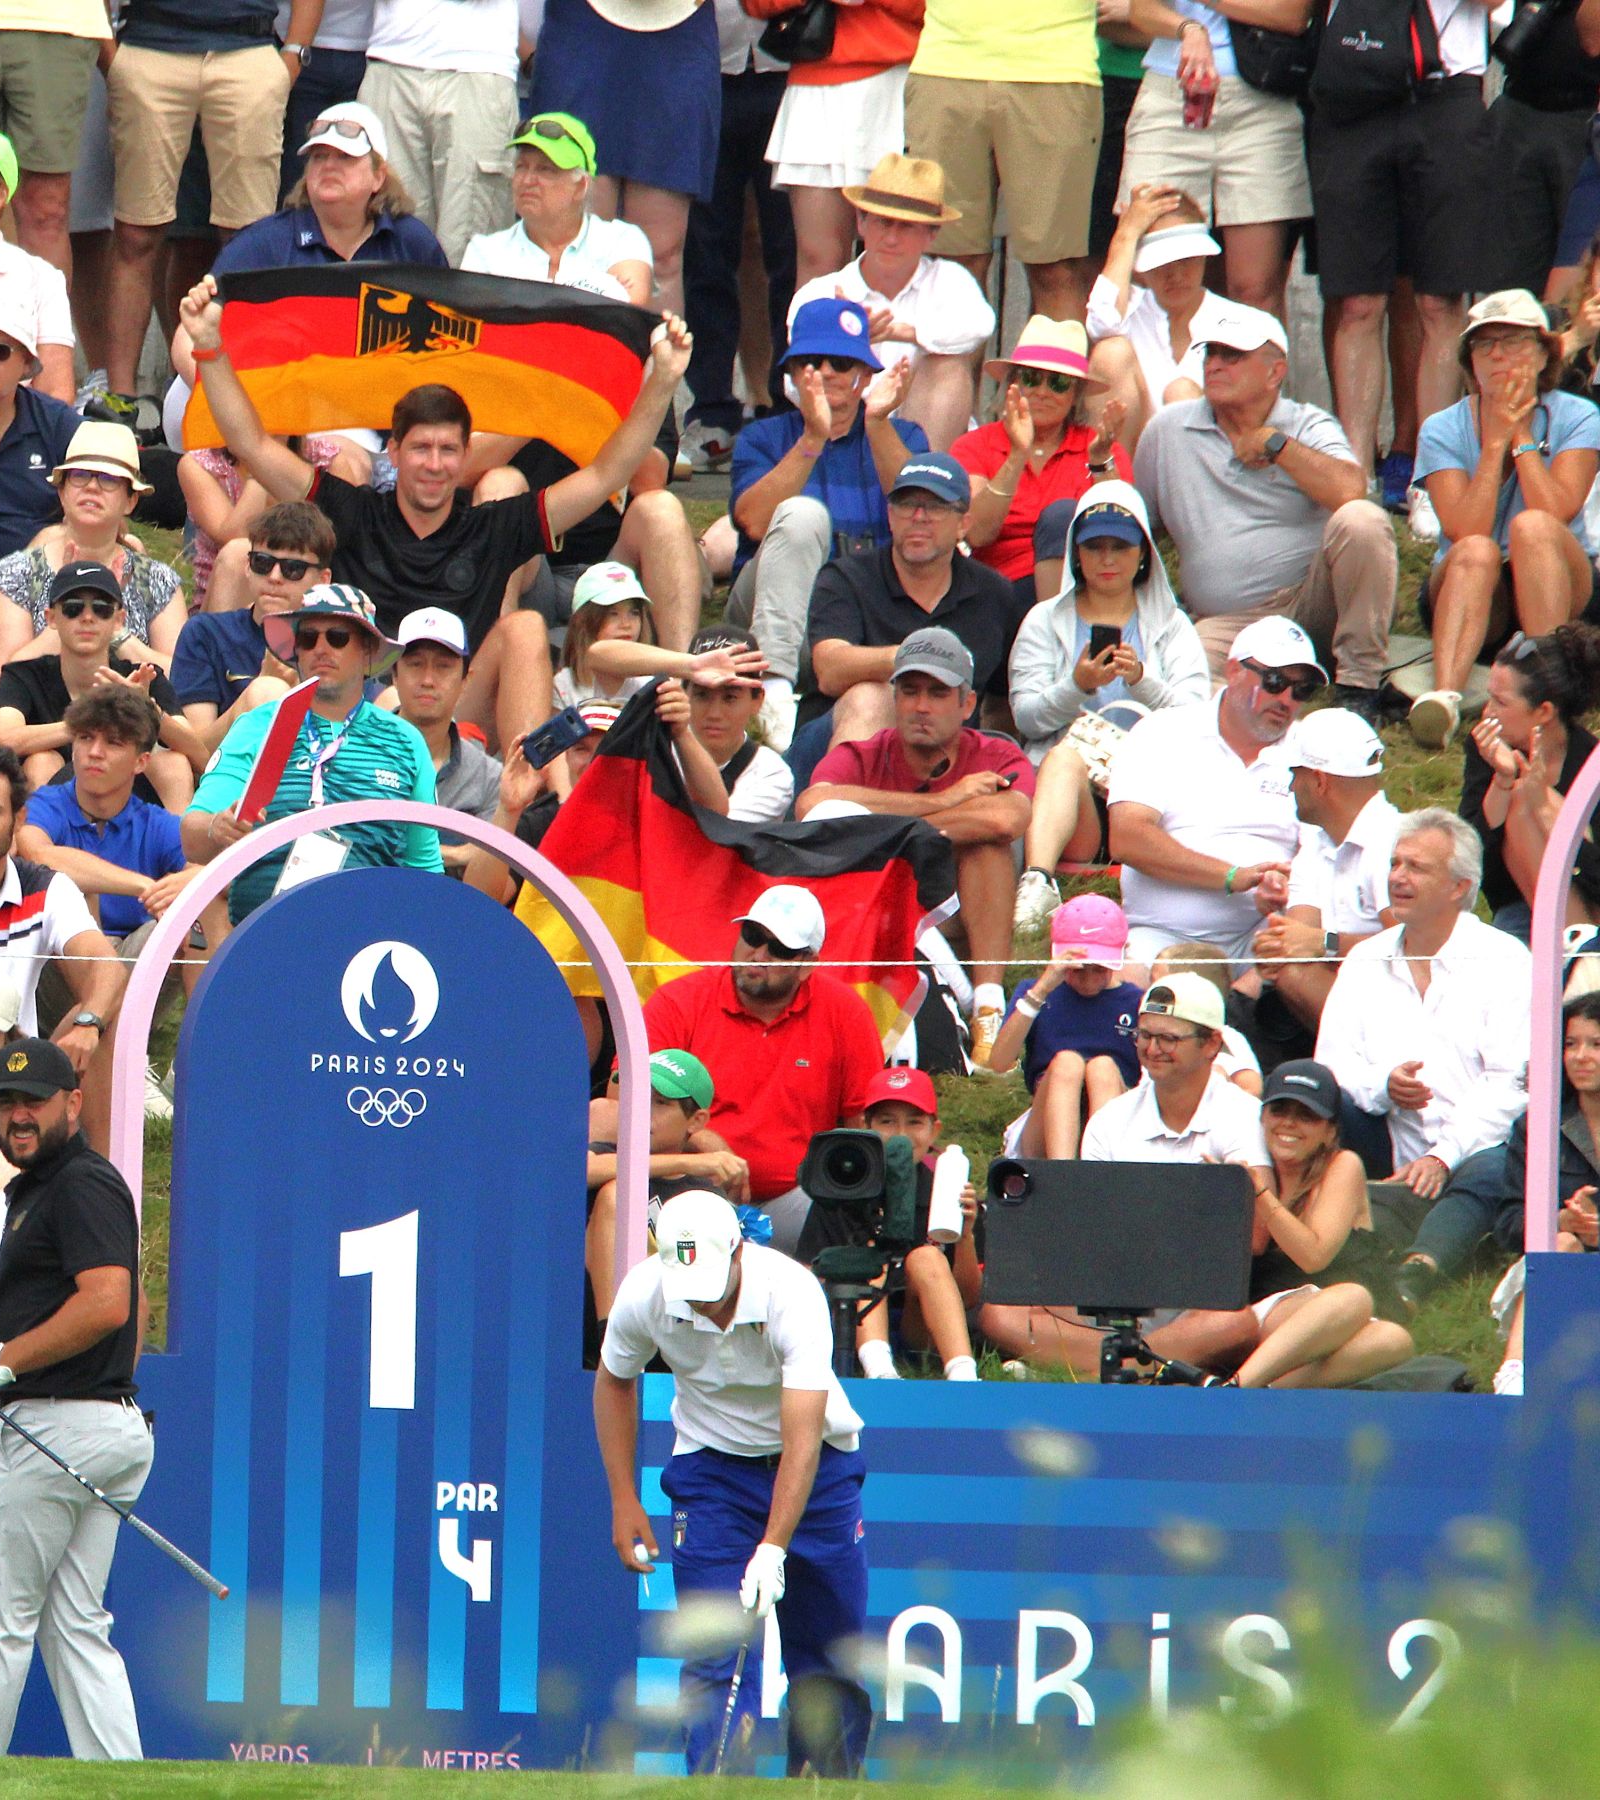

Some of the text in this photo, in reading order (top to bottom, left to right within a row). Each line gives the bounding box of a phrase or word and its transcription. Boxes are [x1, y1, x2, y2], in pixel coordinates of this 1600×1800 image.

[899, 640, 956, 662] Titleist
[396, 1056, 465, 1077] 2024
[339, 1209, 419, 1410] 1
[437, 1481, 499, 1512] PAR
[438, 1518, 492, 1602] 4
[230, 1743, 309, 1765] YARDS
